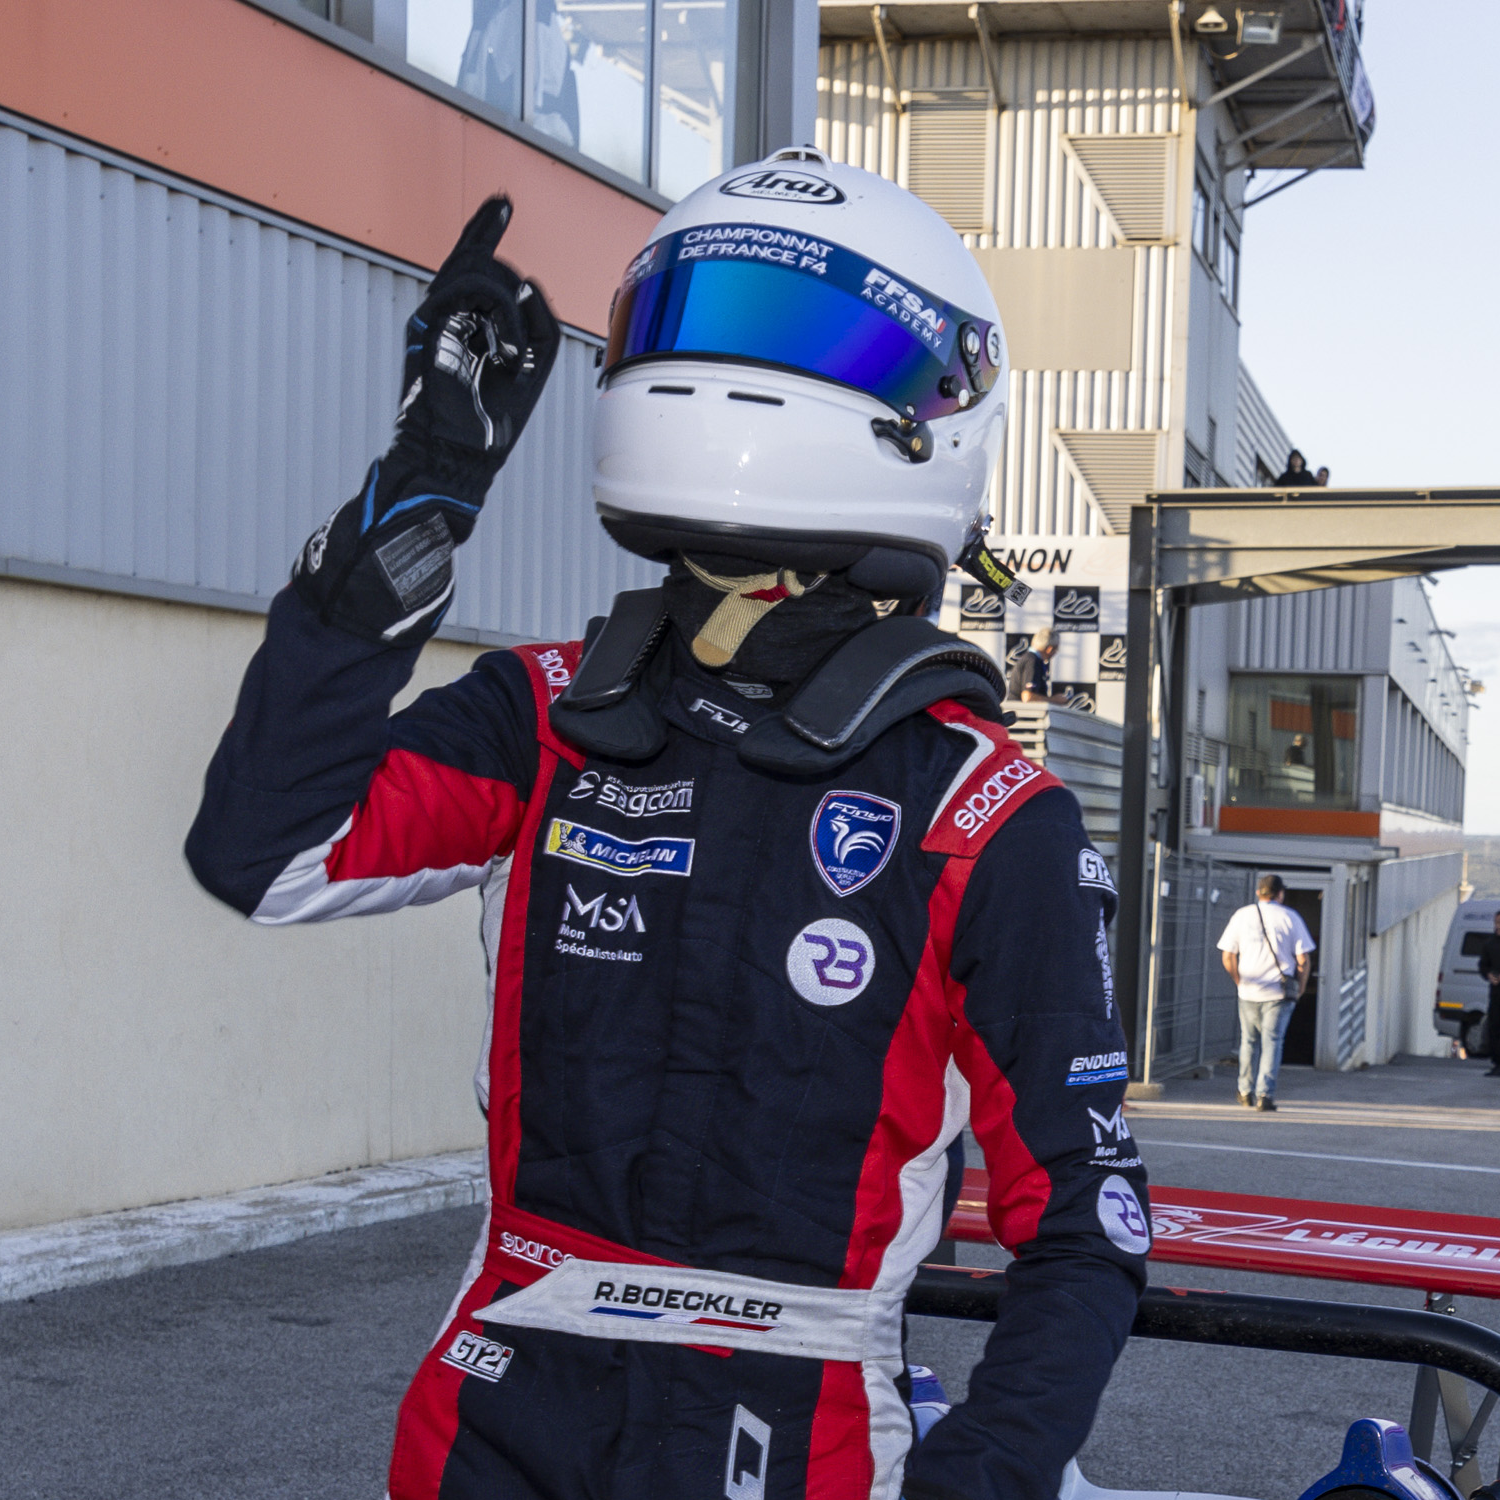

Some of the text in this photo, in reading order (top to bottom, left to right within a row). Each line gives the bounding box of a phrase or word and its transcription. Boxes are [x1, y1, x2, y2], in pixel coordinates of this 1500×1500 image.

[739, 172, 835, 198] Arai
[683, 227, 833, 259] CHAMPIONNAT
[703, 244, 796, 264] FRANCE
[800, 256, 827, 275] F4
[864, 268, 945, 333] FFSA
[861, 286, 943, 349] ACADEMY
[954, 759, 1041, 838] sparco
[590, 842, 677, 863] MICHELIN
[559, 923, 586, 940] Mon
[594, 1281, 783, 1321] R.BOECKLER
